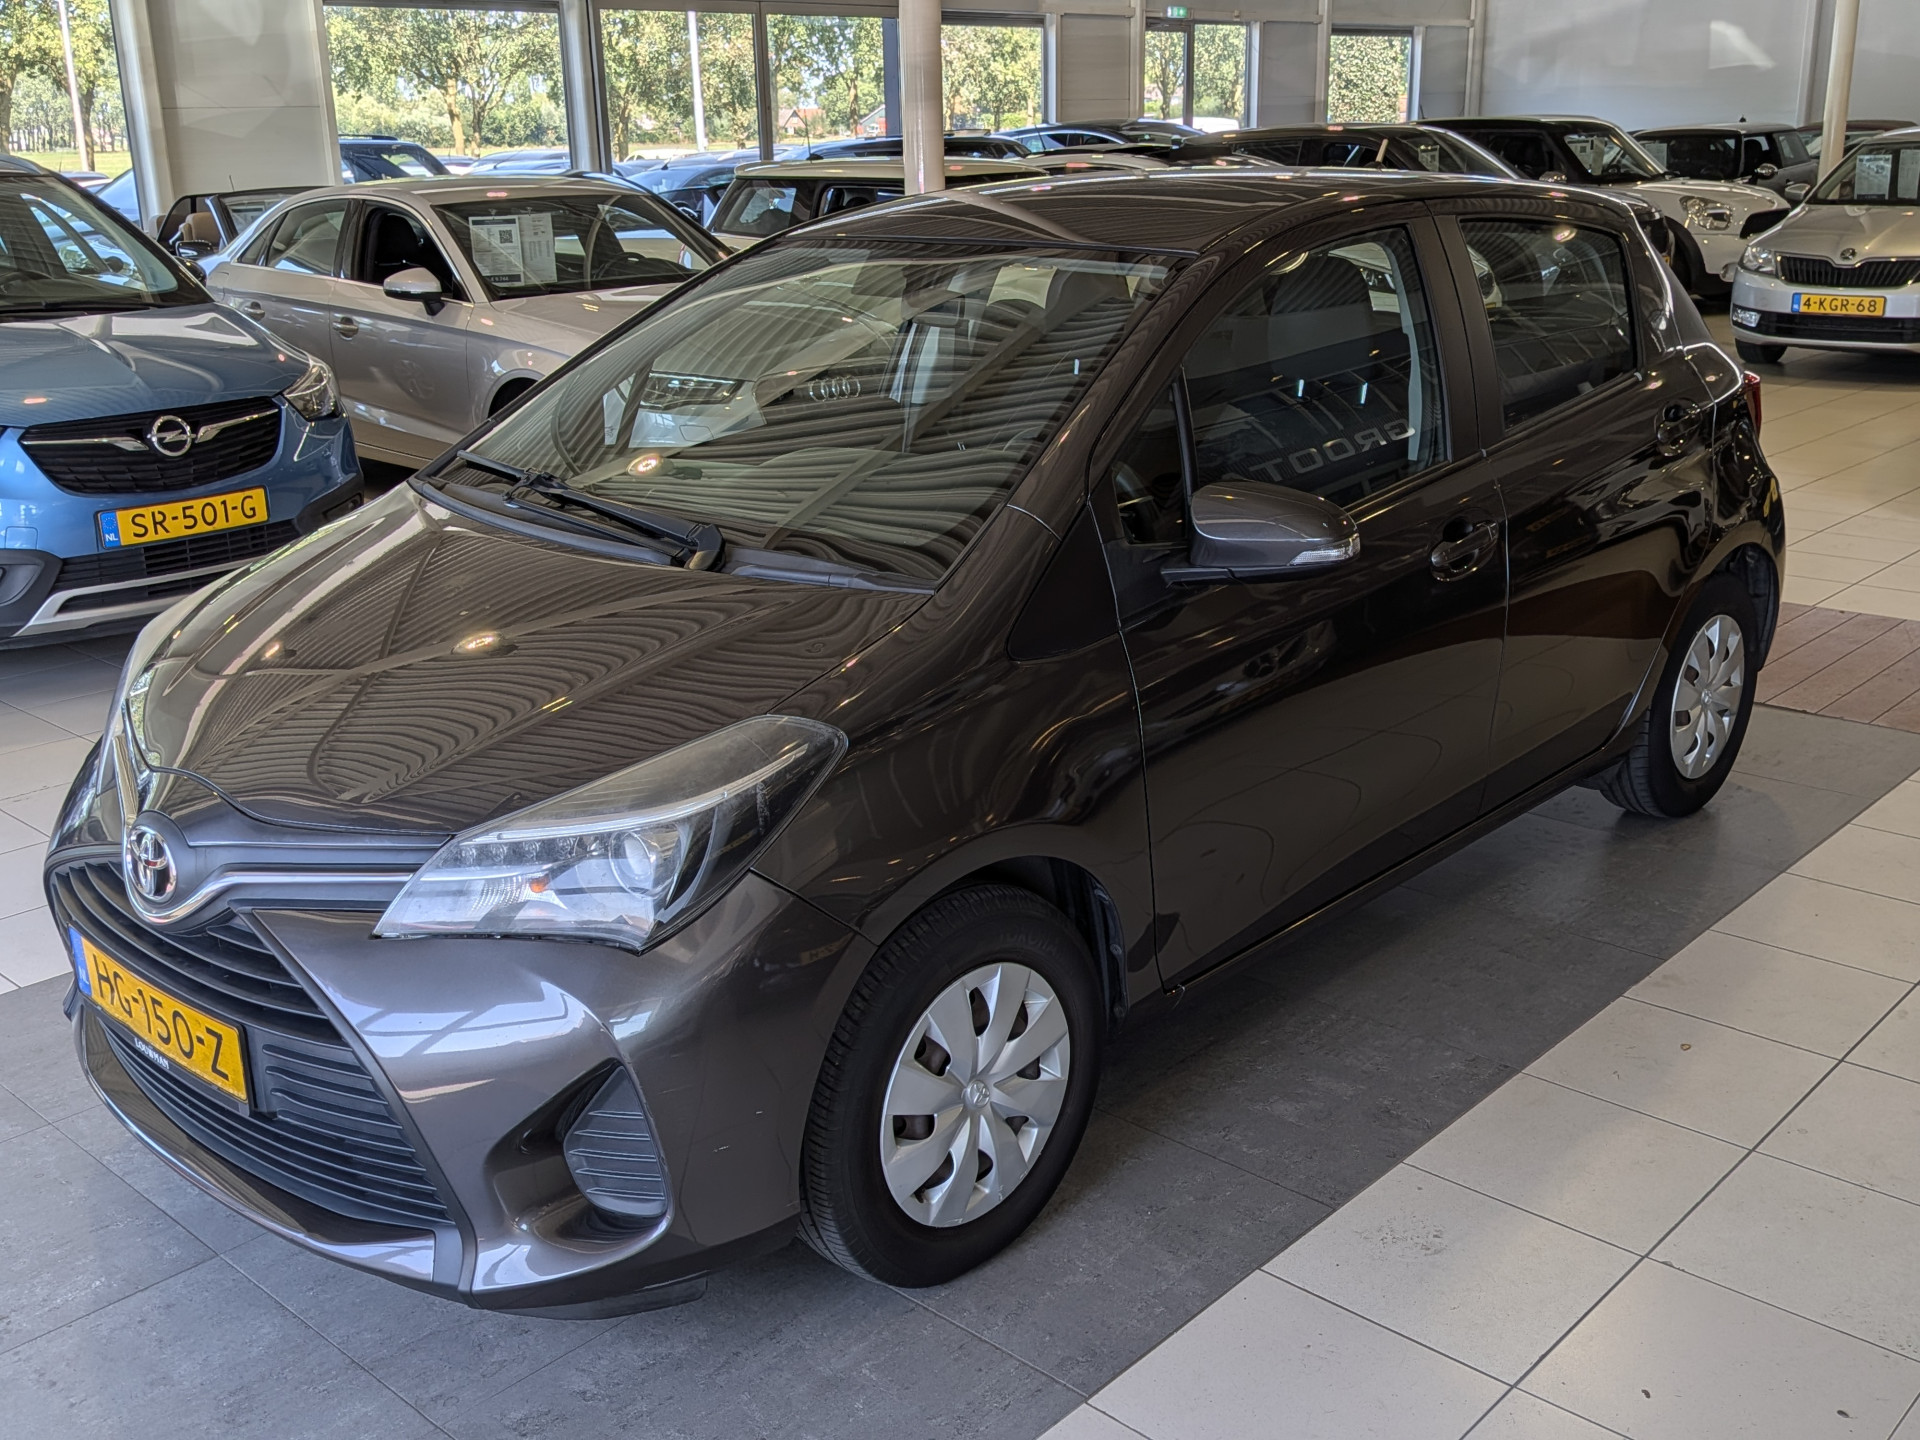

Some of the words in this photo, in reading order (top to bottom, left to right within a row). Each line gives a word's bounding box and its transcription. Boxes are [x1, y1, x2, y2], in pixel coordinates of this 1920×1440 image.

[1803, 297, 1877, 313] 4-KGR-68
[131, 495, 257, 538] SR-501-G
[105, 533, 119, 542] NL
[93, 953, 230, 1082] HG-150-Z
